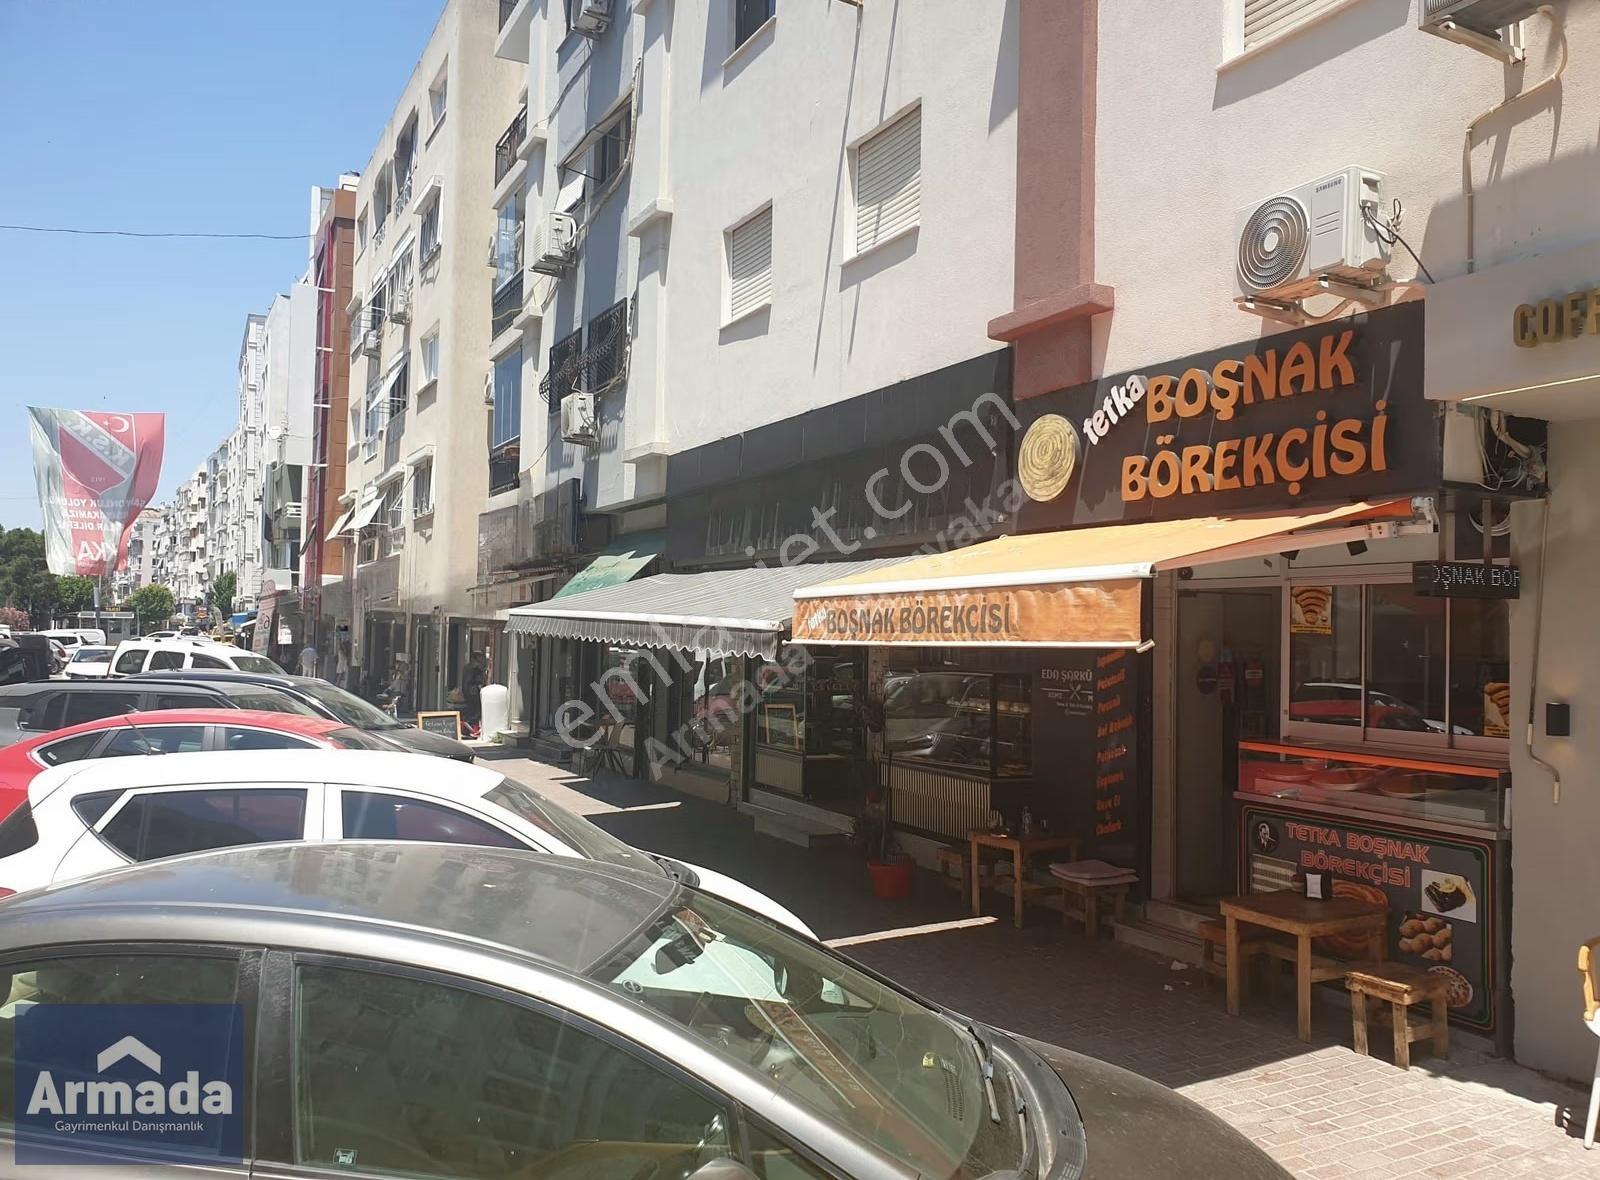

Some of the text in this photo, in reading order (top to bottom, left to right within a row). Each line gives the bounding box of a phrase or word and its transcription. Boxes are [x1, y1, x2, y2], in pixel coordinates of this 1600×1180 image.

[1315, 179, 1342, 193] SAMSUNG
[1083, 330, 1356, 445] tetka BOŞNAK
[1121, 400, 1388, 502] BÖREKÇİSİ
[827, 608, 896, 640] BOŞNAK
[1285, 822, 1431, 864] TETKA BOŞNAK
[1300, 850, 1412, 889] BÖREKÇİSİ
